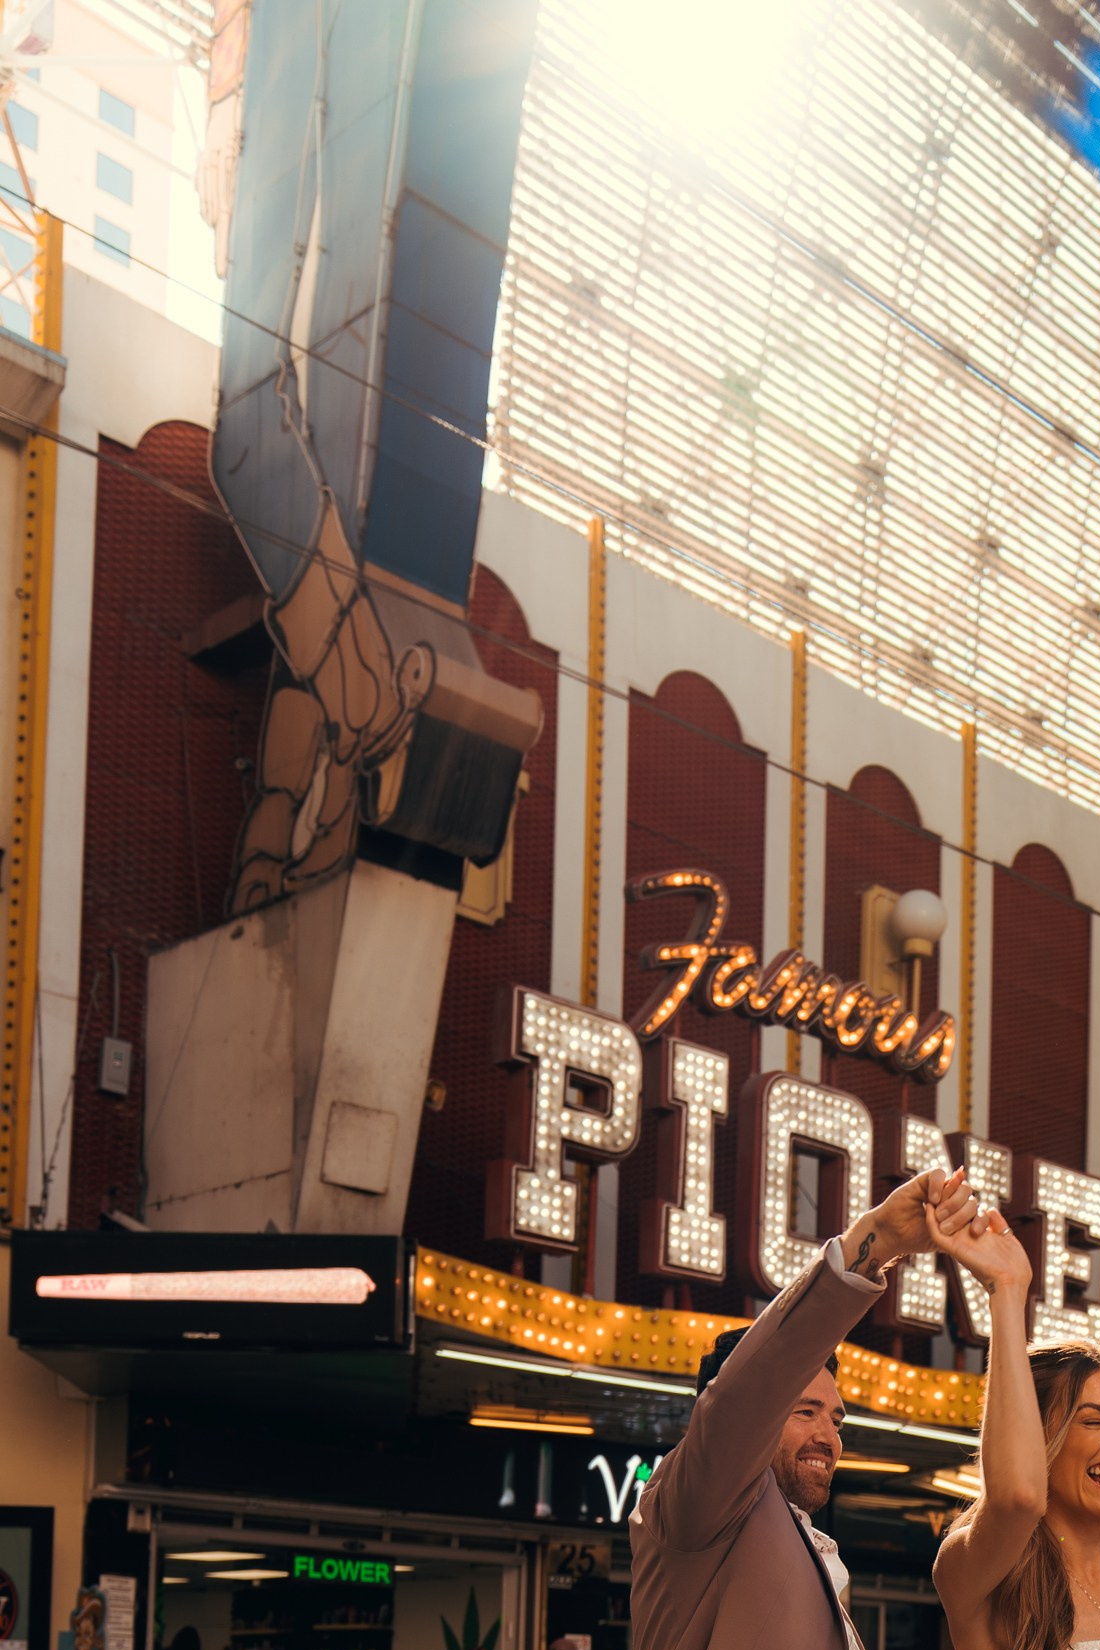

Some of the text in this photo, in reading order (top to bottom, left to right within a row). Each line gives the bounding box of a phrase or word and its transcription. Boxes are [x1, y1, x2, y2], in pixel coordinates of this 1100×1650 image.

[630, 868, 956, 1080] Famous
[60, 1278, 111, 1292] RAW
[294, 1555, 391, 1585] FLOWER
[559, 1543, 597, 1575] 25
